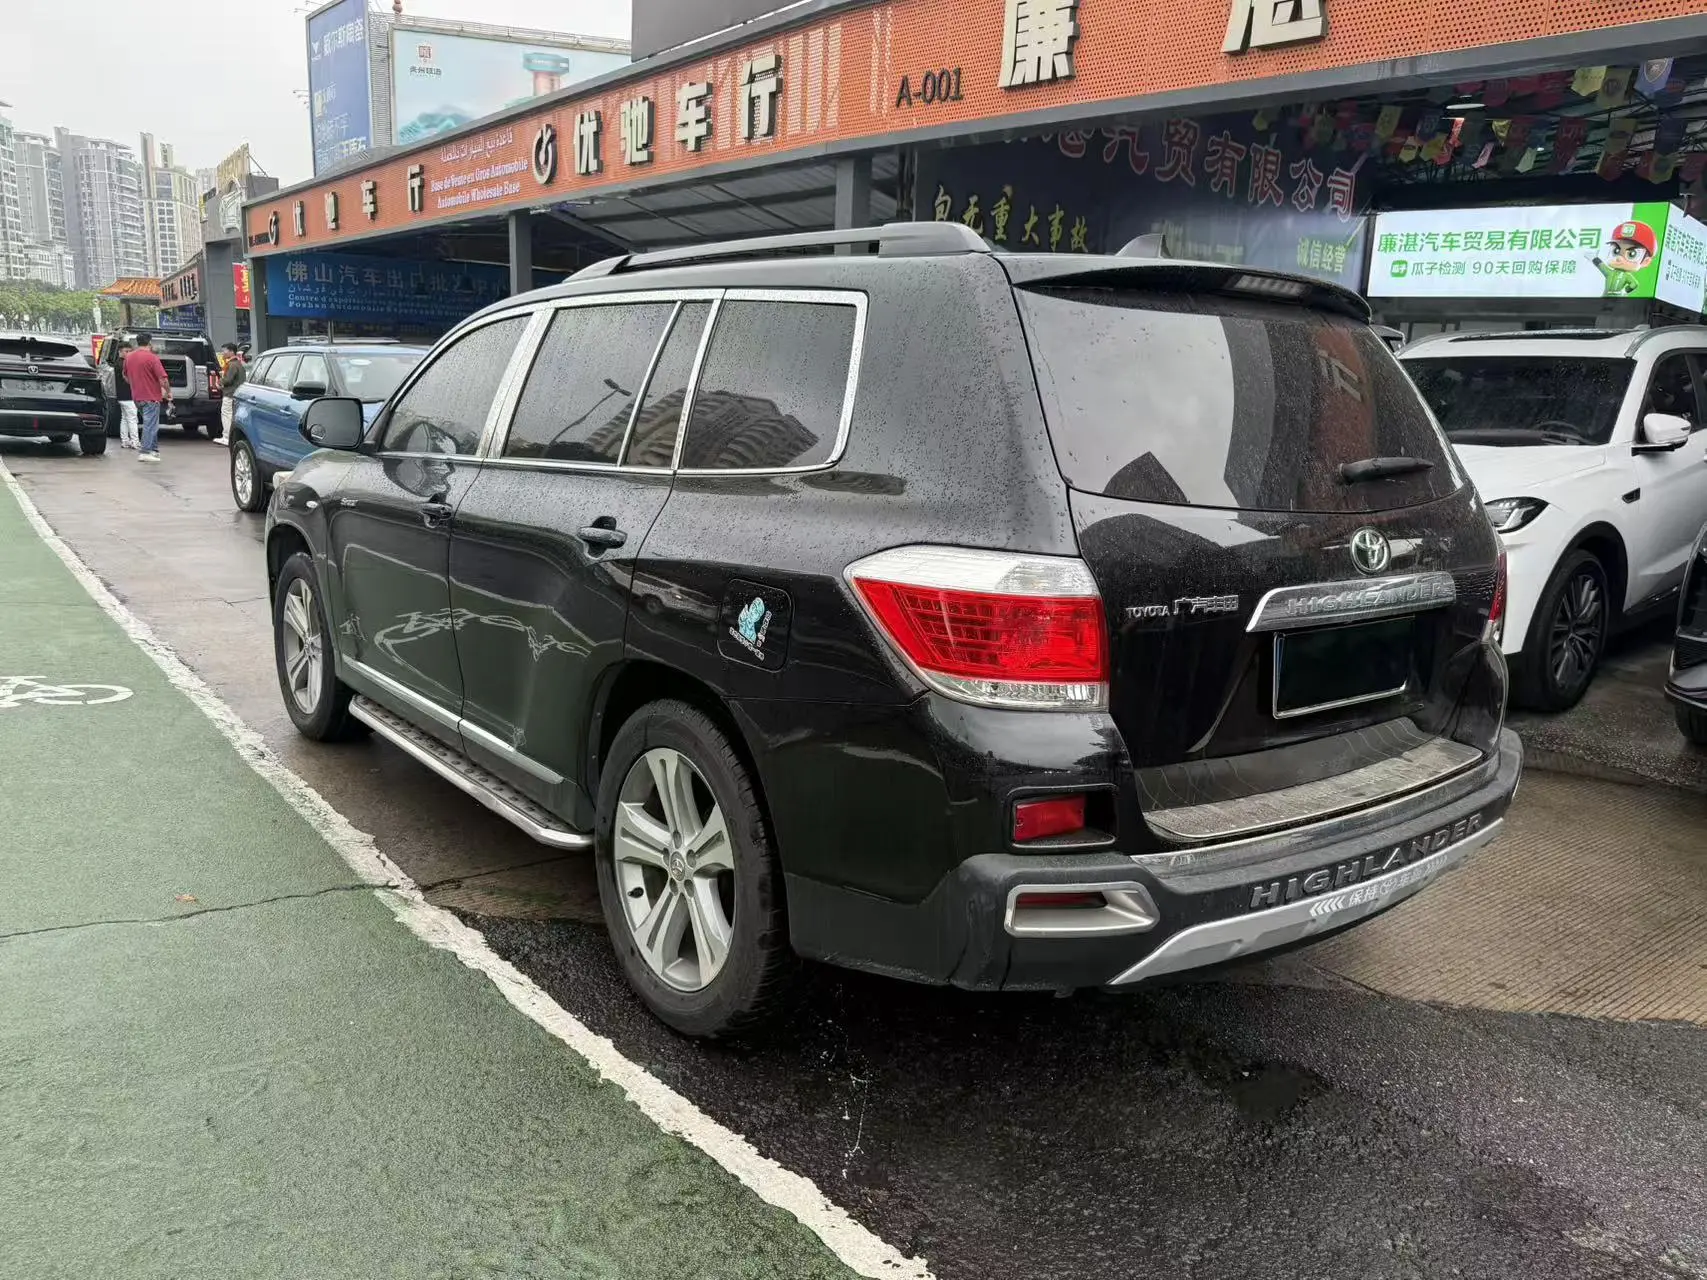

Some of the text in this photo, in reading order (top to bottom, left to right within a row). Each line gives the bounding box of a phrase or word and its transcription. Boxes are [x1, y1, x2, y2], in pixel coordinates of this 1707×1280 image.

[896, 67, 964, 107] A-001
[573, 54, 782, 176] 优驰车行
[475, 167, 490, 181] Gros
[490, 157, 528, 178] Automobile
[438, 181, 520, 209] Automobile Wholesale Base
[1378, 228, 1602, 253] 廉湛汽车贸易有限公司
[1411, 260, 1466, 276] 瓜子检测
[1472, 259, 1577, 276] 90天回购保障
[1125, 605, 1170, 618] TOYOTA
[1287, 581, 1450, 616] HIGHLANDER
[1250, 813, 1482, 908] HIGHLANDER
